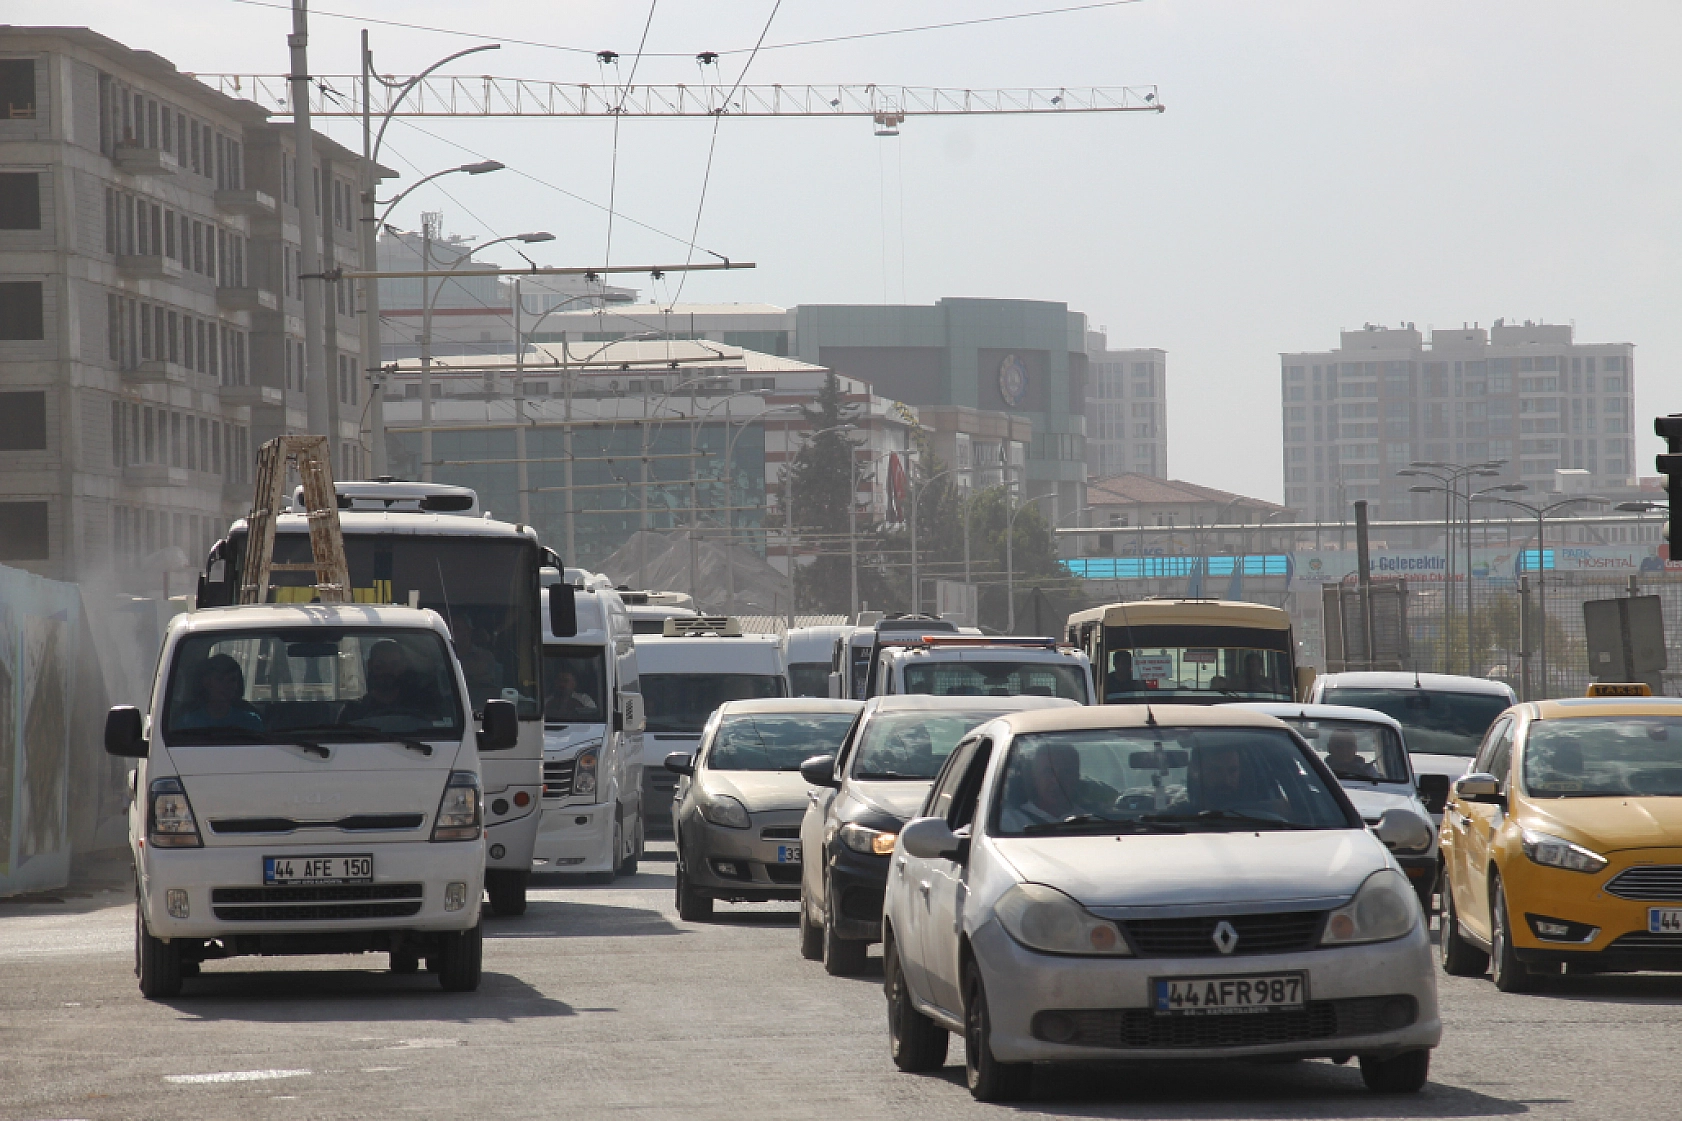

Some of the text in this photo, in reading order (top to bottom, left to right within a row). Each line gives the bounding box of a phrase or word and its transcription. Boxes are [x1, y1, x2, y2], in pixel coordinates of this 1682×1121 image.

[1562, 548, 1592, 559] PARK
[1578, 553, 1637, 568] HOSPITAL
[275, 860, 294, 877] 44
[303, 860, 333, 877] AFE
[342, 859, 370, 876] 150
[1661, 912, 1680, 931] 44
